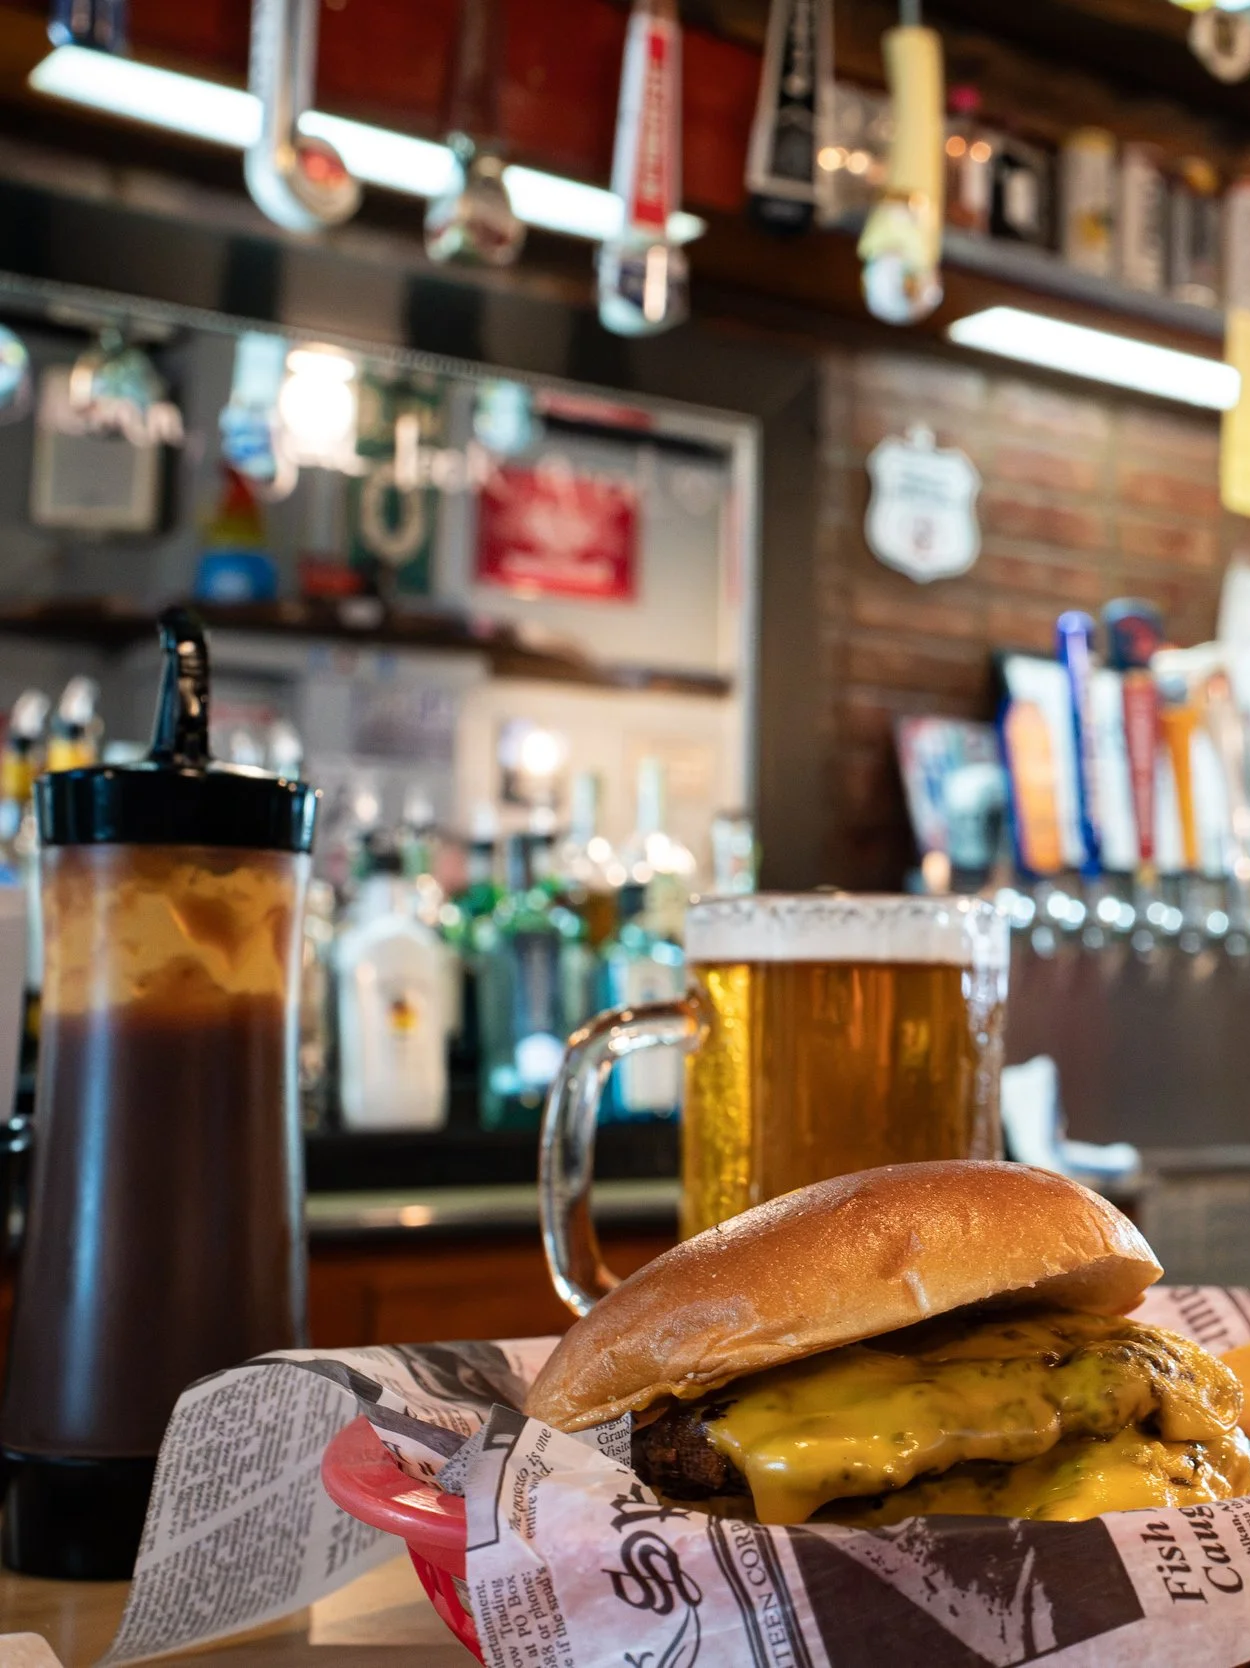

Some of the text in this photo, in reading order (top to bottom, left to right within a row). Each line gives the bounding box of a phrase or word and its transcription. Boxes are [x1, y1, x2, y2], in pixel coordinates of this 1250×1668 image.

[525, 1451, 541, 1466] is
[535, 1428, 553, 1452] one
[525, 1495, 538, 1539] entire
[1141, 1520, 1208, 1604] Fish
[1178, 1504, 1244, 1594] Caug
[491, 1578, 514, 1639] Trading
[520, 1571, 548, 1620] phone:
[535, 1566, 559, 1612] spud's
[730, 1518, 794, 1668] TEEN CORP
[505, 1574, 539, 1658] at PO Box
[537, 1623, 551, 1640] or
[552, 1614, 567, 1638] the
[556, 1640, 571, 1655] if
